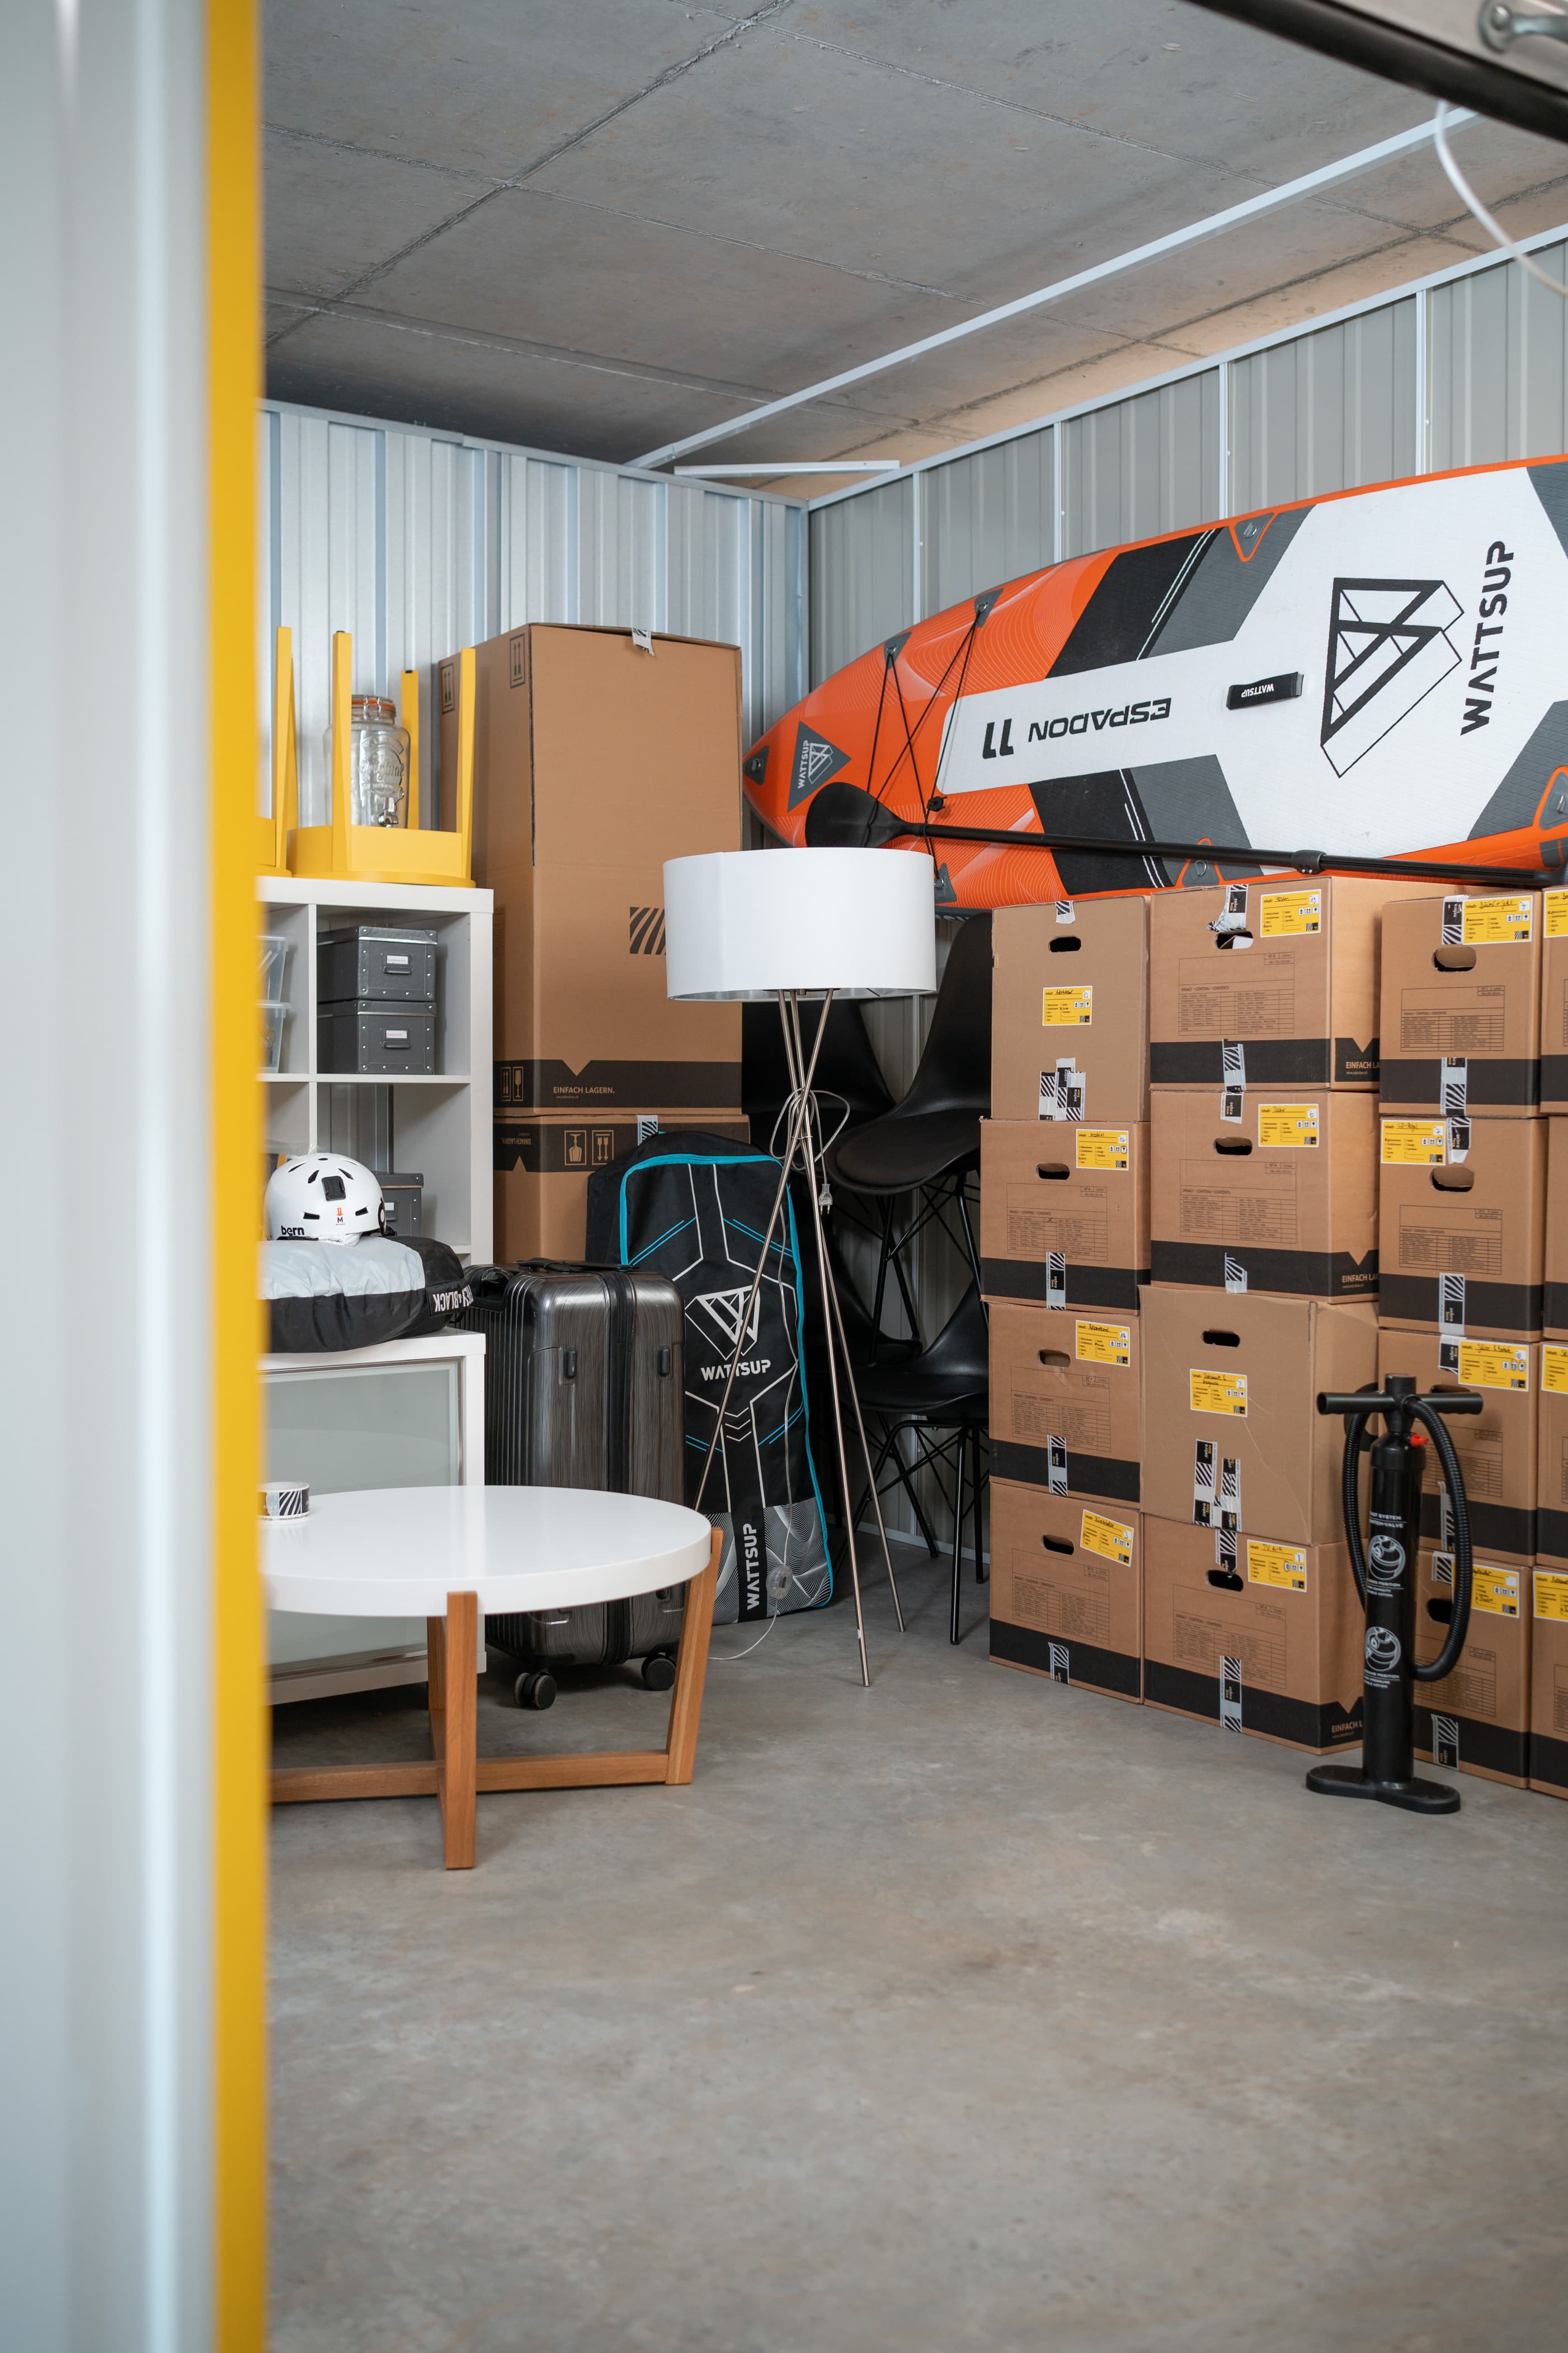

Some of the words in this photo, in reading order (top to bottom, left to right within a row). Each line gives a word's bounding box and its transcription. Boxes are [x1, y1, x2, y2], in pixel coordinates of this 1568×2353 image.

[1460, 541, 1514, 735] WATTSUP
[1241, 683, 1274, 698] WATTSUP
[1028, 697, 1171, 743] ESPADON
[797, 740, 810, 789] WATTSUP
[281, 1225, 304, 1236] bern
[1342, 1274, 1368, 1283] EINFACH
[432, 1290, 459, 1312] BLACK
[700, 1359, 771, 1380] WATTSUP
[742, 1523, 760, 1610] WATTSUP
[1331, 1721, 1358, 1733] EINFACH
